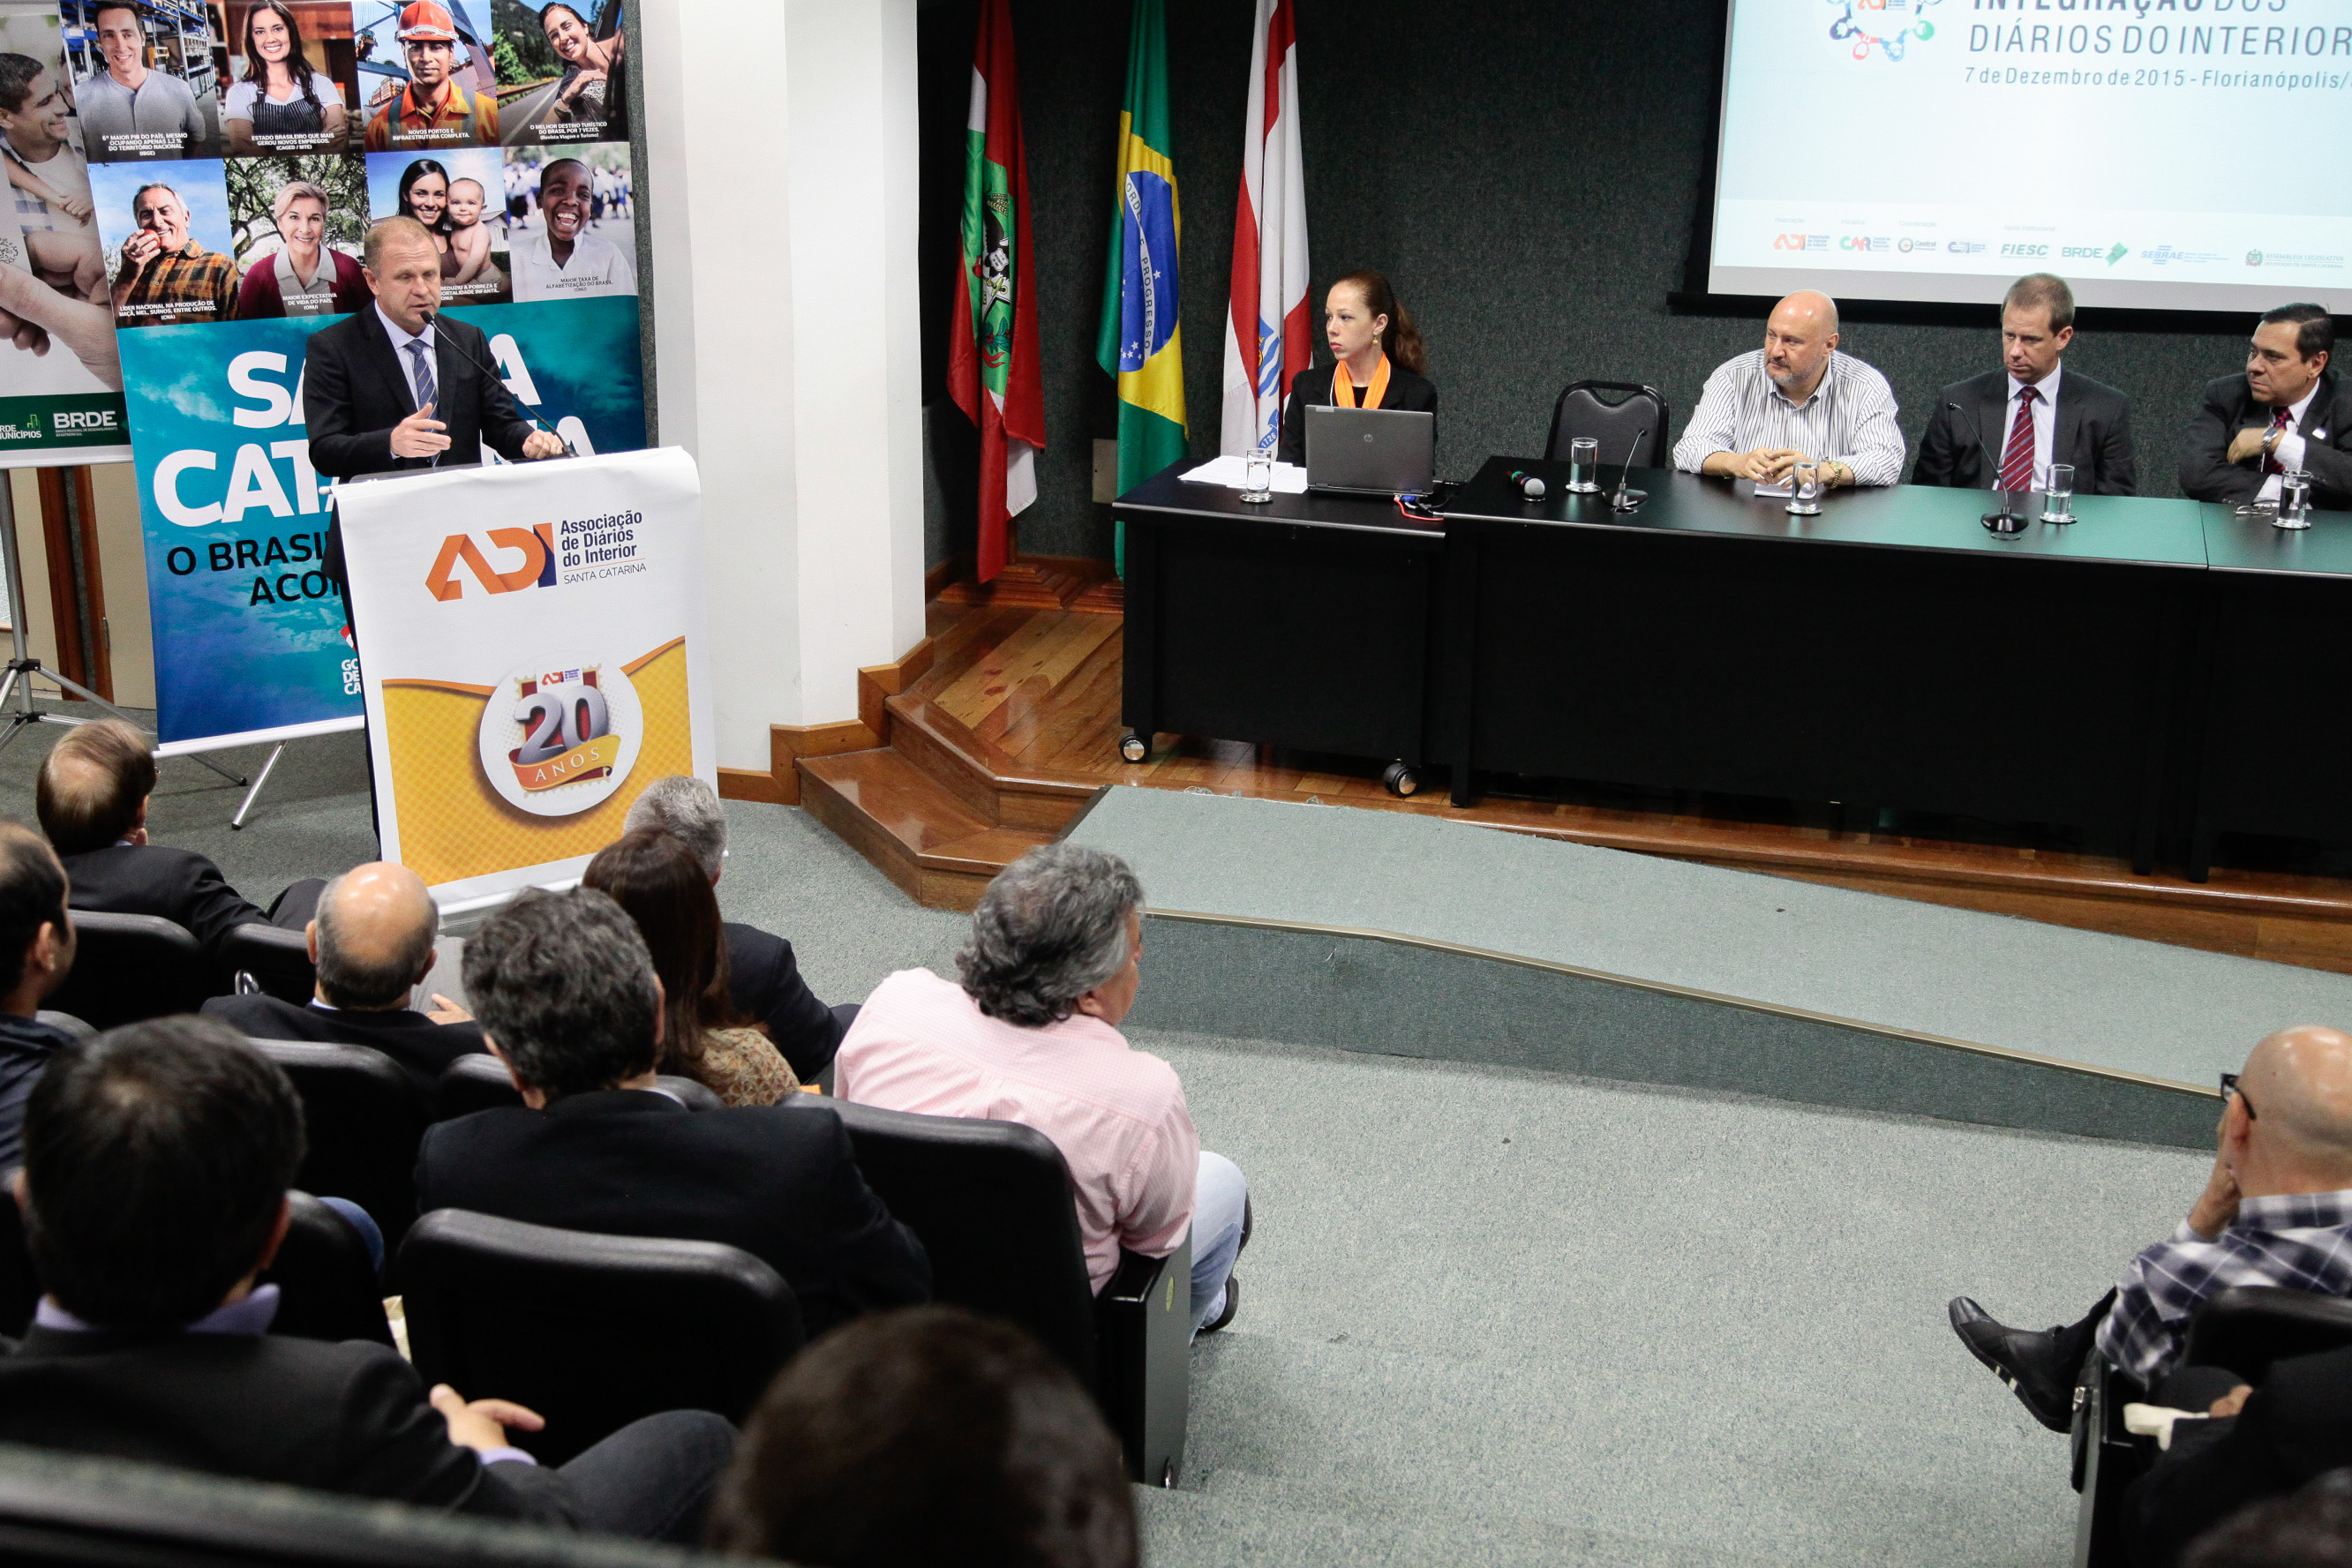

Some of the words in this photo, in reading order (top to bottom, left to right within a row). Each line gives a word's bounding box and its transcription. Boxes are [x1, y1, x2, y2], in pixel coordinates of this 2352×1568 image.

[1969, 18, 2112, 54] DIÁRIOS
[2123, 26, 2168, 55] DO
[2179, 26, 2352, 56] INTERIOR
[1965, 67, 1975, 83] 7
[1979, 67, 2001, 84] de
[2005, 67, 2102, 85] Dezembro
[2108, 69, 2130, 86] de
[2134, 69, 2184, 86] 2015
[2202, 70, 2352, 91] Florianópolis/
[2000, 244, 2048, 256] FIESC
[2061, 247, 2104, 259] BRDE
[2140, 251, 2184, 260] SEBRAE
[1125, 183, 1141, 220] ORDE
[1141, 257, 1153, 349] PROGRESSO
[53, 410, 117, 429] BRDE
[1261, 431, 1277, 447] 1726
[560, 510, 642, 536] Associação
[561, 536, 579, 551] de
[583, 529, 634, 548] Diários
[167, 546, 196, 575] O
[208, 530, 328, 572] BRASI
[425, 522, 557, 602] ADI
[563, 551, 581, 567] do
[585, 544, 637, 564] Interior
[563, 571, 597, 584] SANTA
[598, 563, 647, 579] CATARINA
[541, 671, 564, 686] ADI
[515, 685, 609, 765] 20
[534, 747, 600, 782] ANOS
